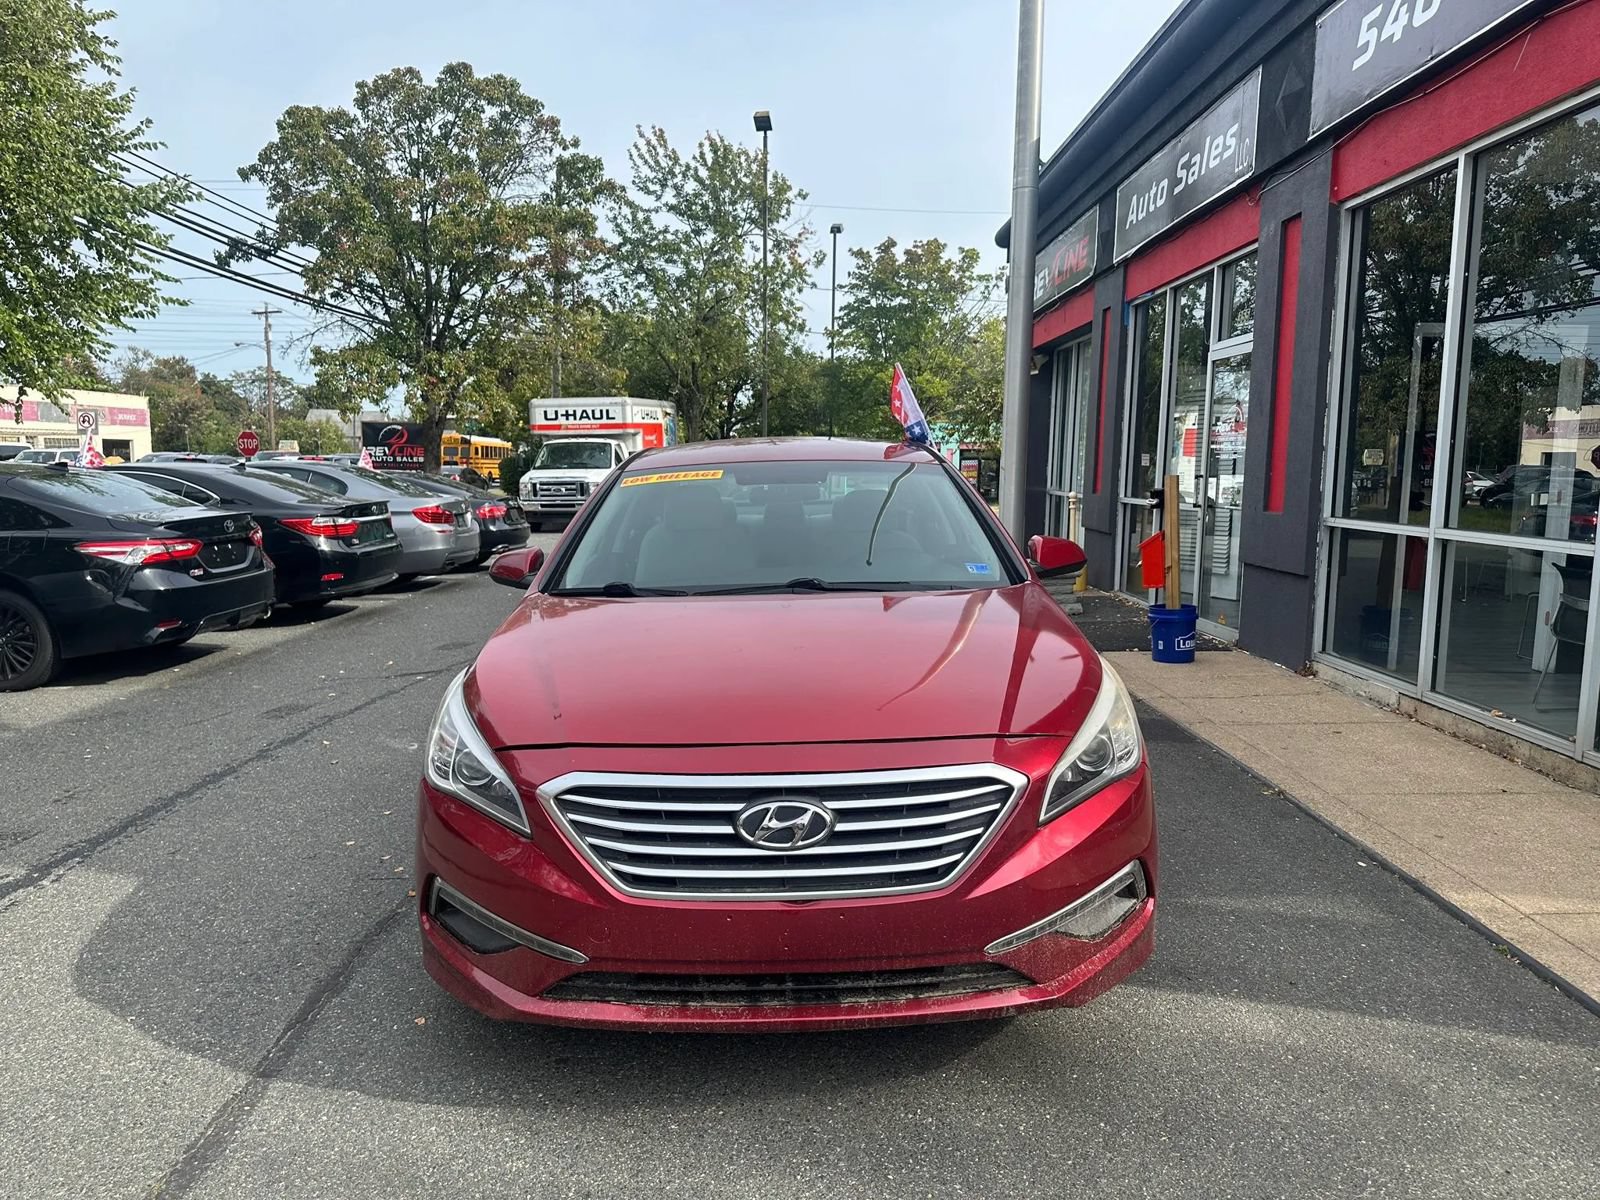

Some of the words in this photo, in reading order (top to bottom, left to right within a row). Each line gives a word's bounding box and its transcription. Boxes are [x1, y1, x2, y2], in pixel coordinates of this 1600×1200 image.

[1234, 138, 1250, 173] LLC
[1125, 178, 1168, 230] Auto
[1173, 122, 1239, 196] Sales
[1034, 234, 1090, 300] EVLINE
[239, 438, 258, 449] STOP
[622, 476, 653, 486] LOW
[655, 471, 721, 481] MILEAGE
